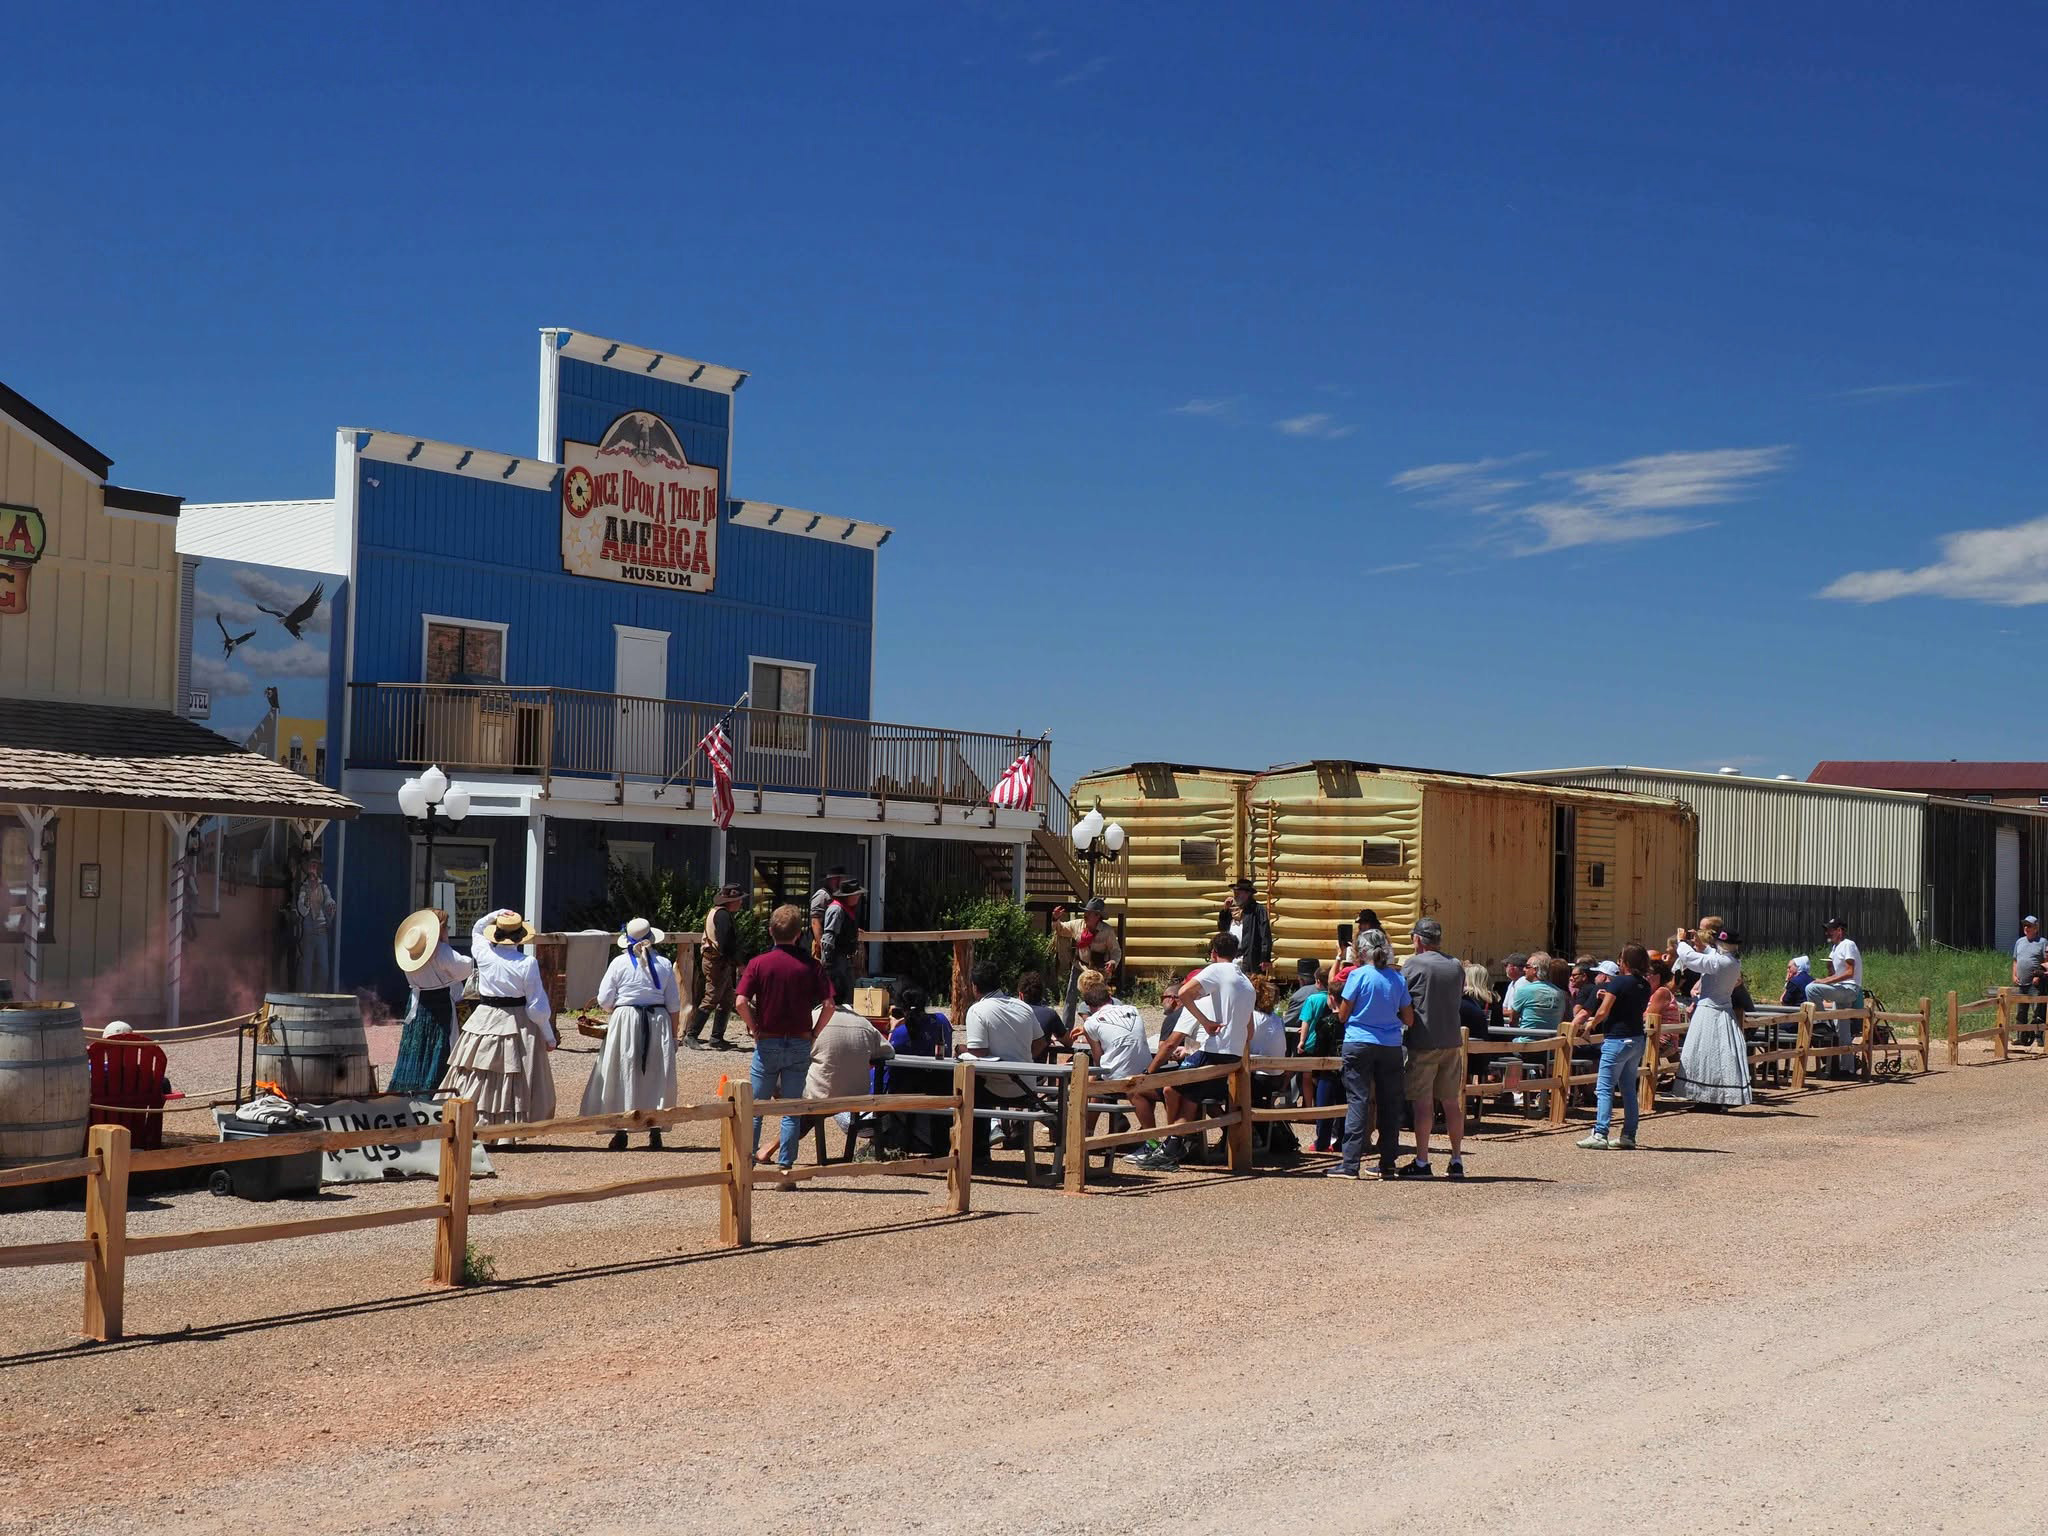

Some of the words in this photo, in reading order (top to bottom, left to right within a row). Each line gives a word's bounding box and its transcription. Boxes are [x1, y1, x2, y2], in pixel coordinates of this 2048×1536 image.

[564, 466, 619, 518] ONCE
[622, 470, 655, 519] UPON
[655, 482, 666, 525] A
[669, 482, 700, 524] TIME
[702, 486, 717, 527] IN
[600, 516, 711, 574] AMERICA
[621, 566, 692, 587] MUSEUM
